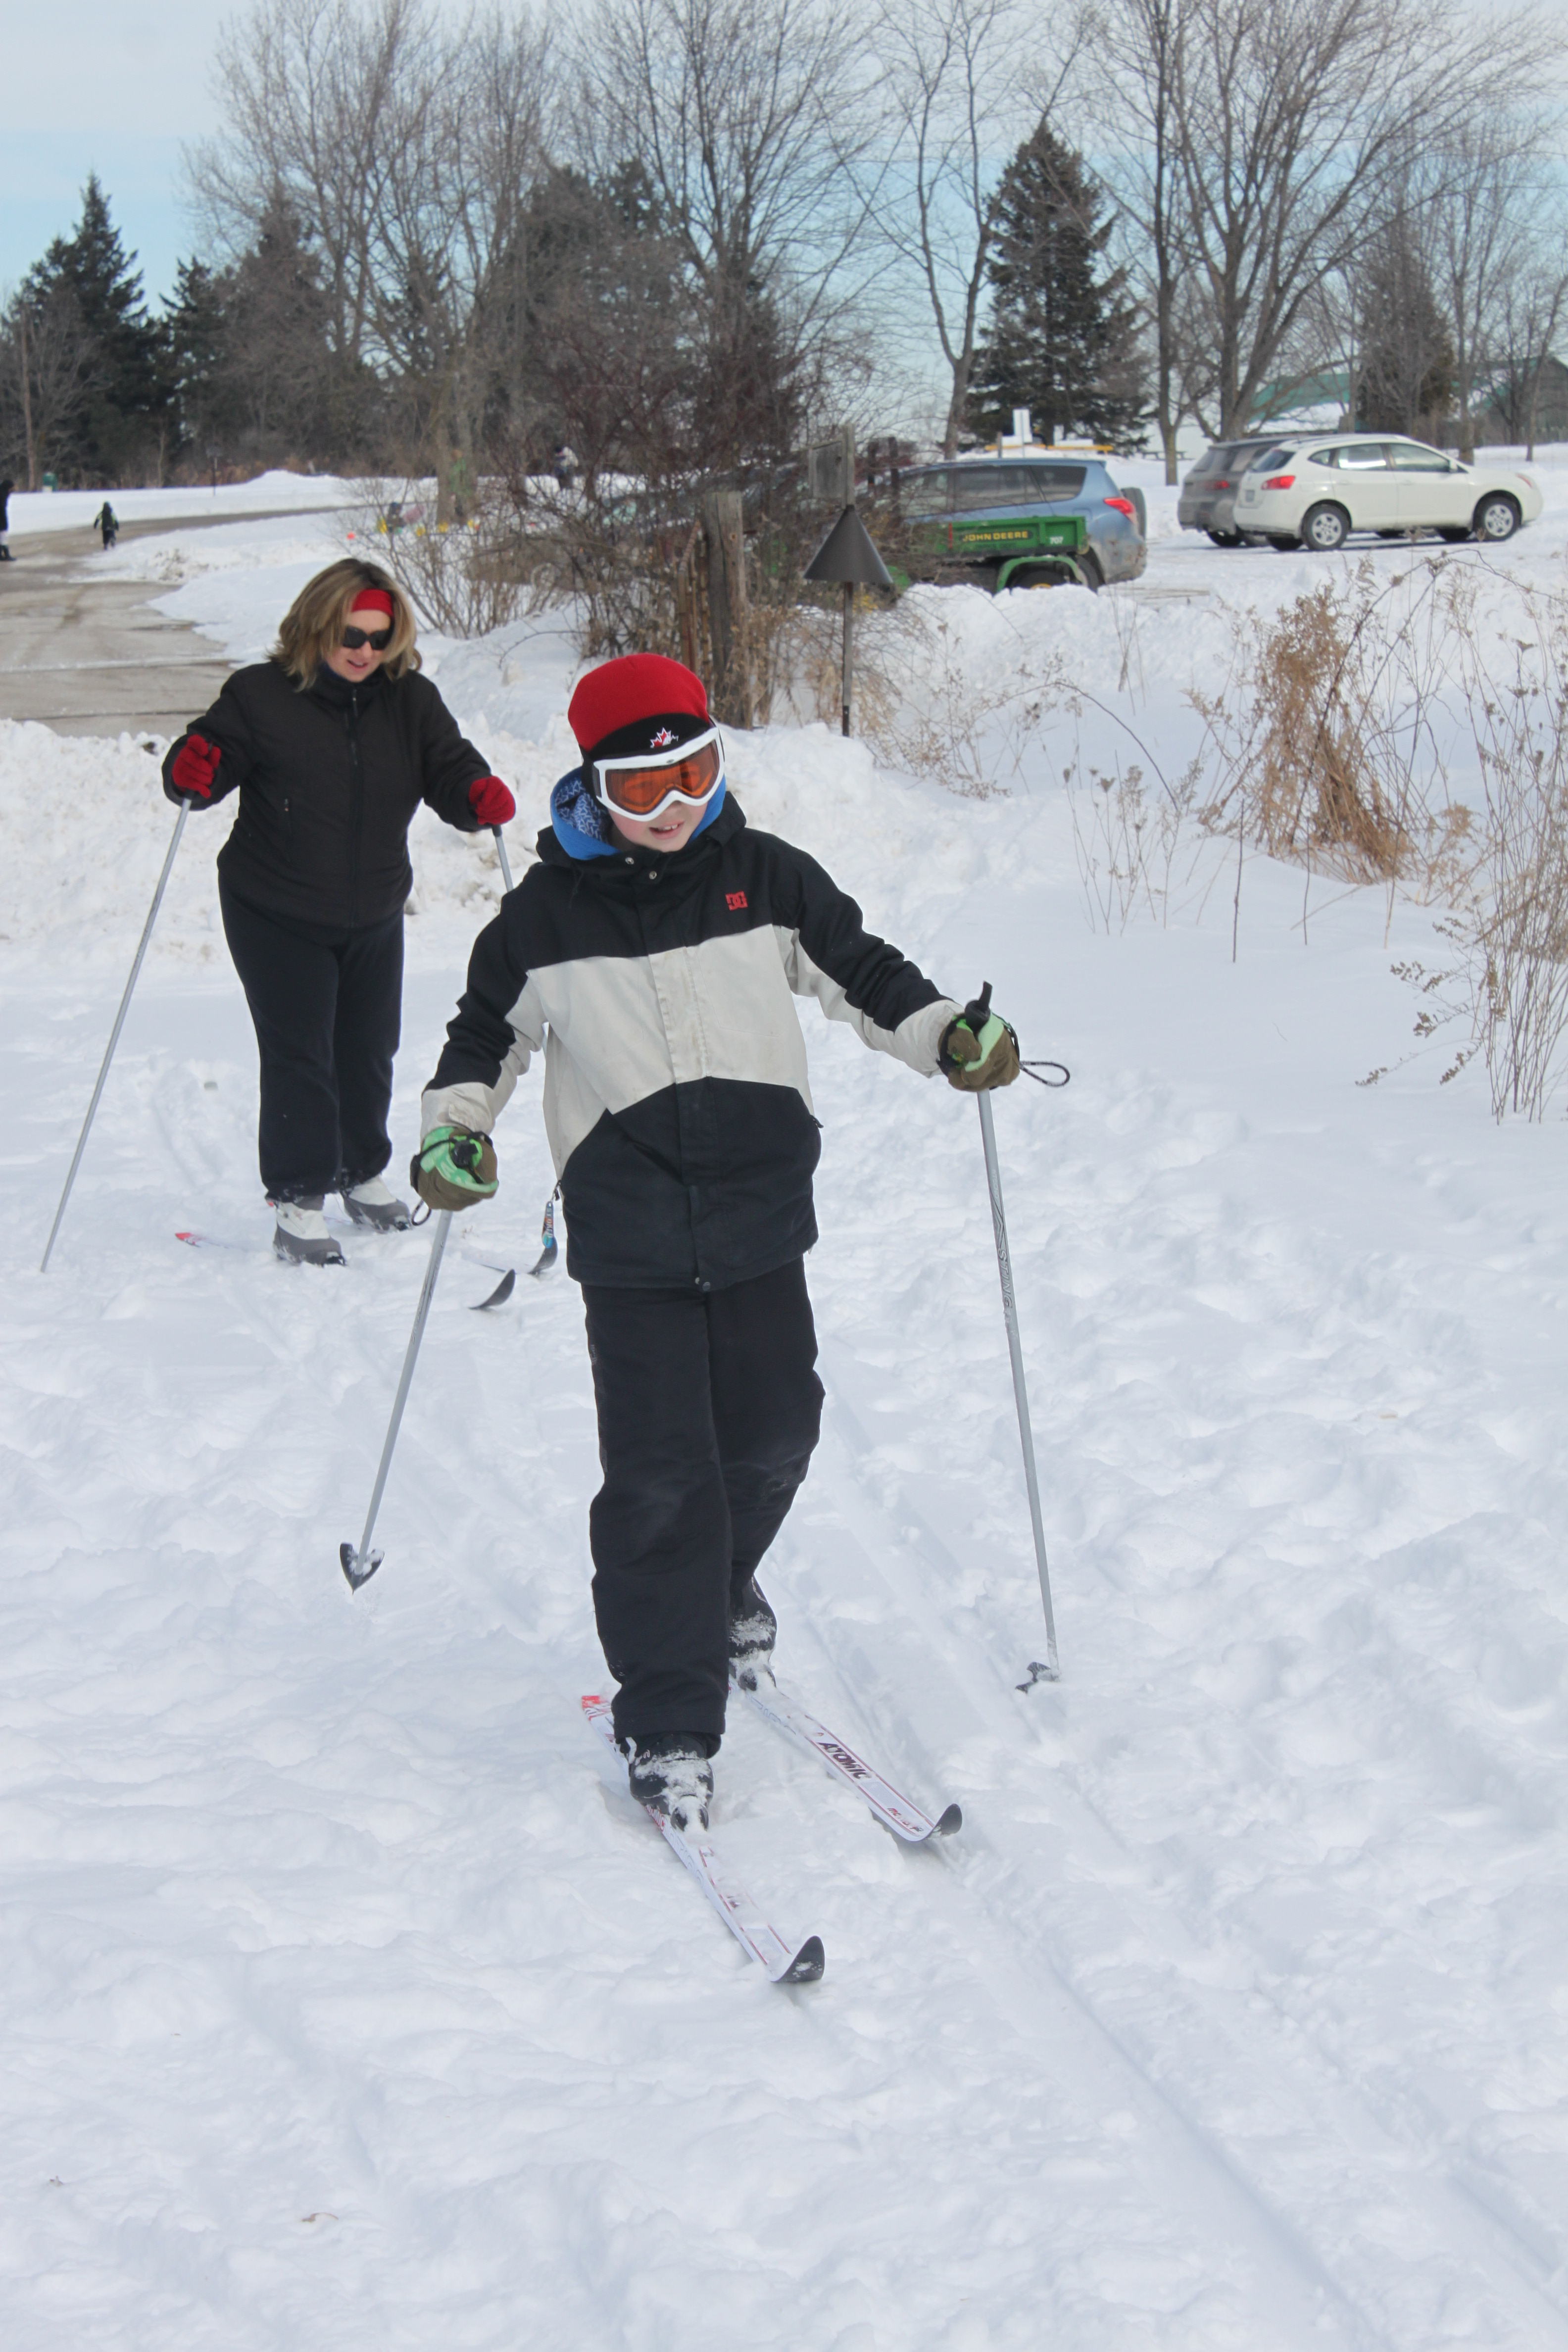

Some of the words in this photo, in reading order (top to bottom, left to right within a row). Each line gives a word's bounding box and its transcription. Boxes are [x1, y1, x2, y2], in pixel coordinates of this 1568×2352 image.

[963, 533, 991, 542] JOHN
[993, 531, 1028, 540] DEERE
[1050, 536, 1064, 544] 707
[998, 1247, 1013, 1308] STING
[818, 1742, 872, 1779] ATOMIC
